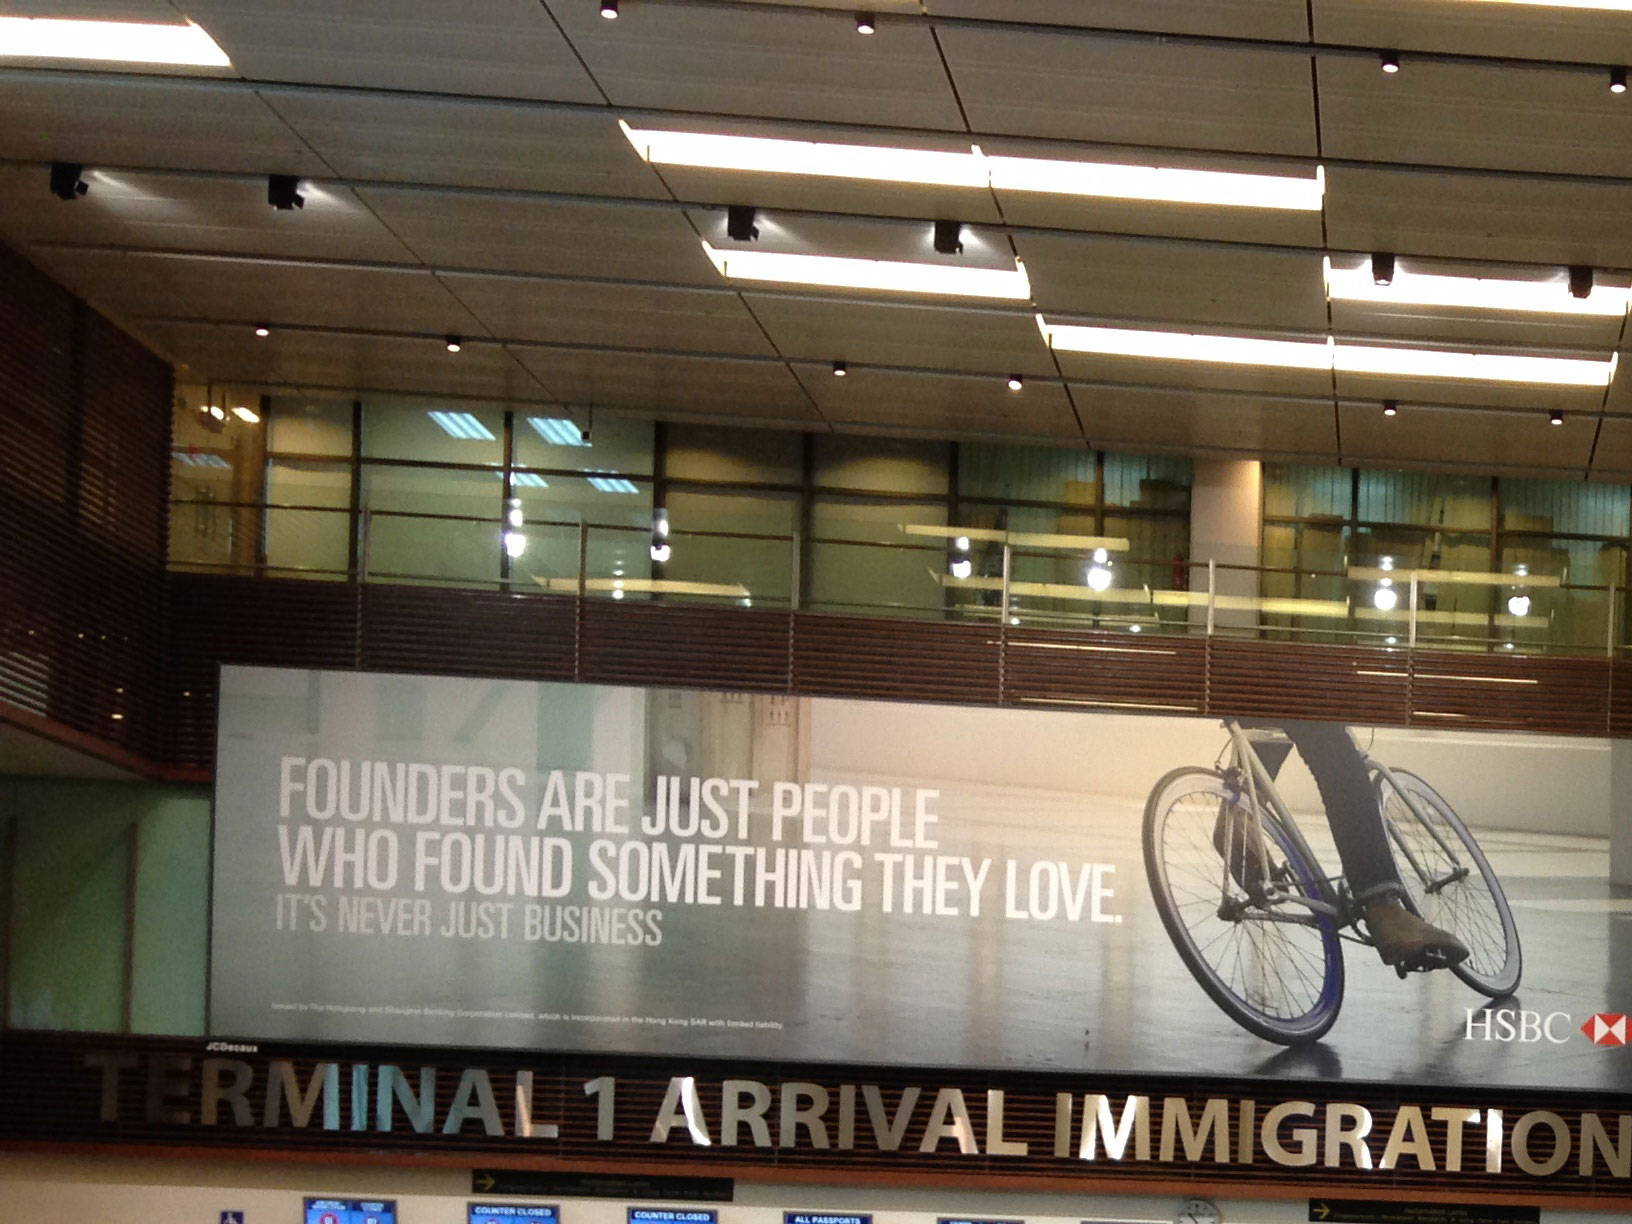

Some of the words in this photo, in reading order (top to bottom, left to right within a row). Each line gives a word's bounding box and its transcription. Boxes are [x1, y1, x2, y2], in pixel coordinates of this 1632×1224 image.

[279, 756, 526, 828] FOUNDERS
[536, 770, 631, 834] ARE
[641, 775, 759, 841] JUST
[772, 781, 940, 849] PEOPLE
[277, 825, 399, 891] WHO
[413, 831, 573, 897] FOUND
[587, 839, 863, 912] SOMETHING
[873, 851, 992, 917] THEY
[1003, 859, 1124, 924] LOVE.
[275, 893, 328, 932] IT'S
[338, 895, 431, 938] NEVER
[440, 901, 514, 940] JUST
[524, 903, 663, 947] BUSINESS
[1464, 1008, 1573, 1045] HSBC
[206, 1041, 258, 1053] JCDecaux
[84, 1053, 560, 1138] TERMINAL
[583, 1075, 617, 1142] 1
[649, 1075, 1029, 1158] ARRIVAL
[1054, 1091, 1632, 1180] IMMIGRATION
[475, 1206, 516, 1215] COUNTER
[517, 1207, 552, 1217] CLOSED
[634, 1211, 675, 1221] COUNTER
[676, 1212, 710, 1221] CLOSED
[794, 1216, 811, 1224] ALL
